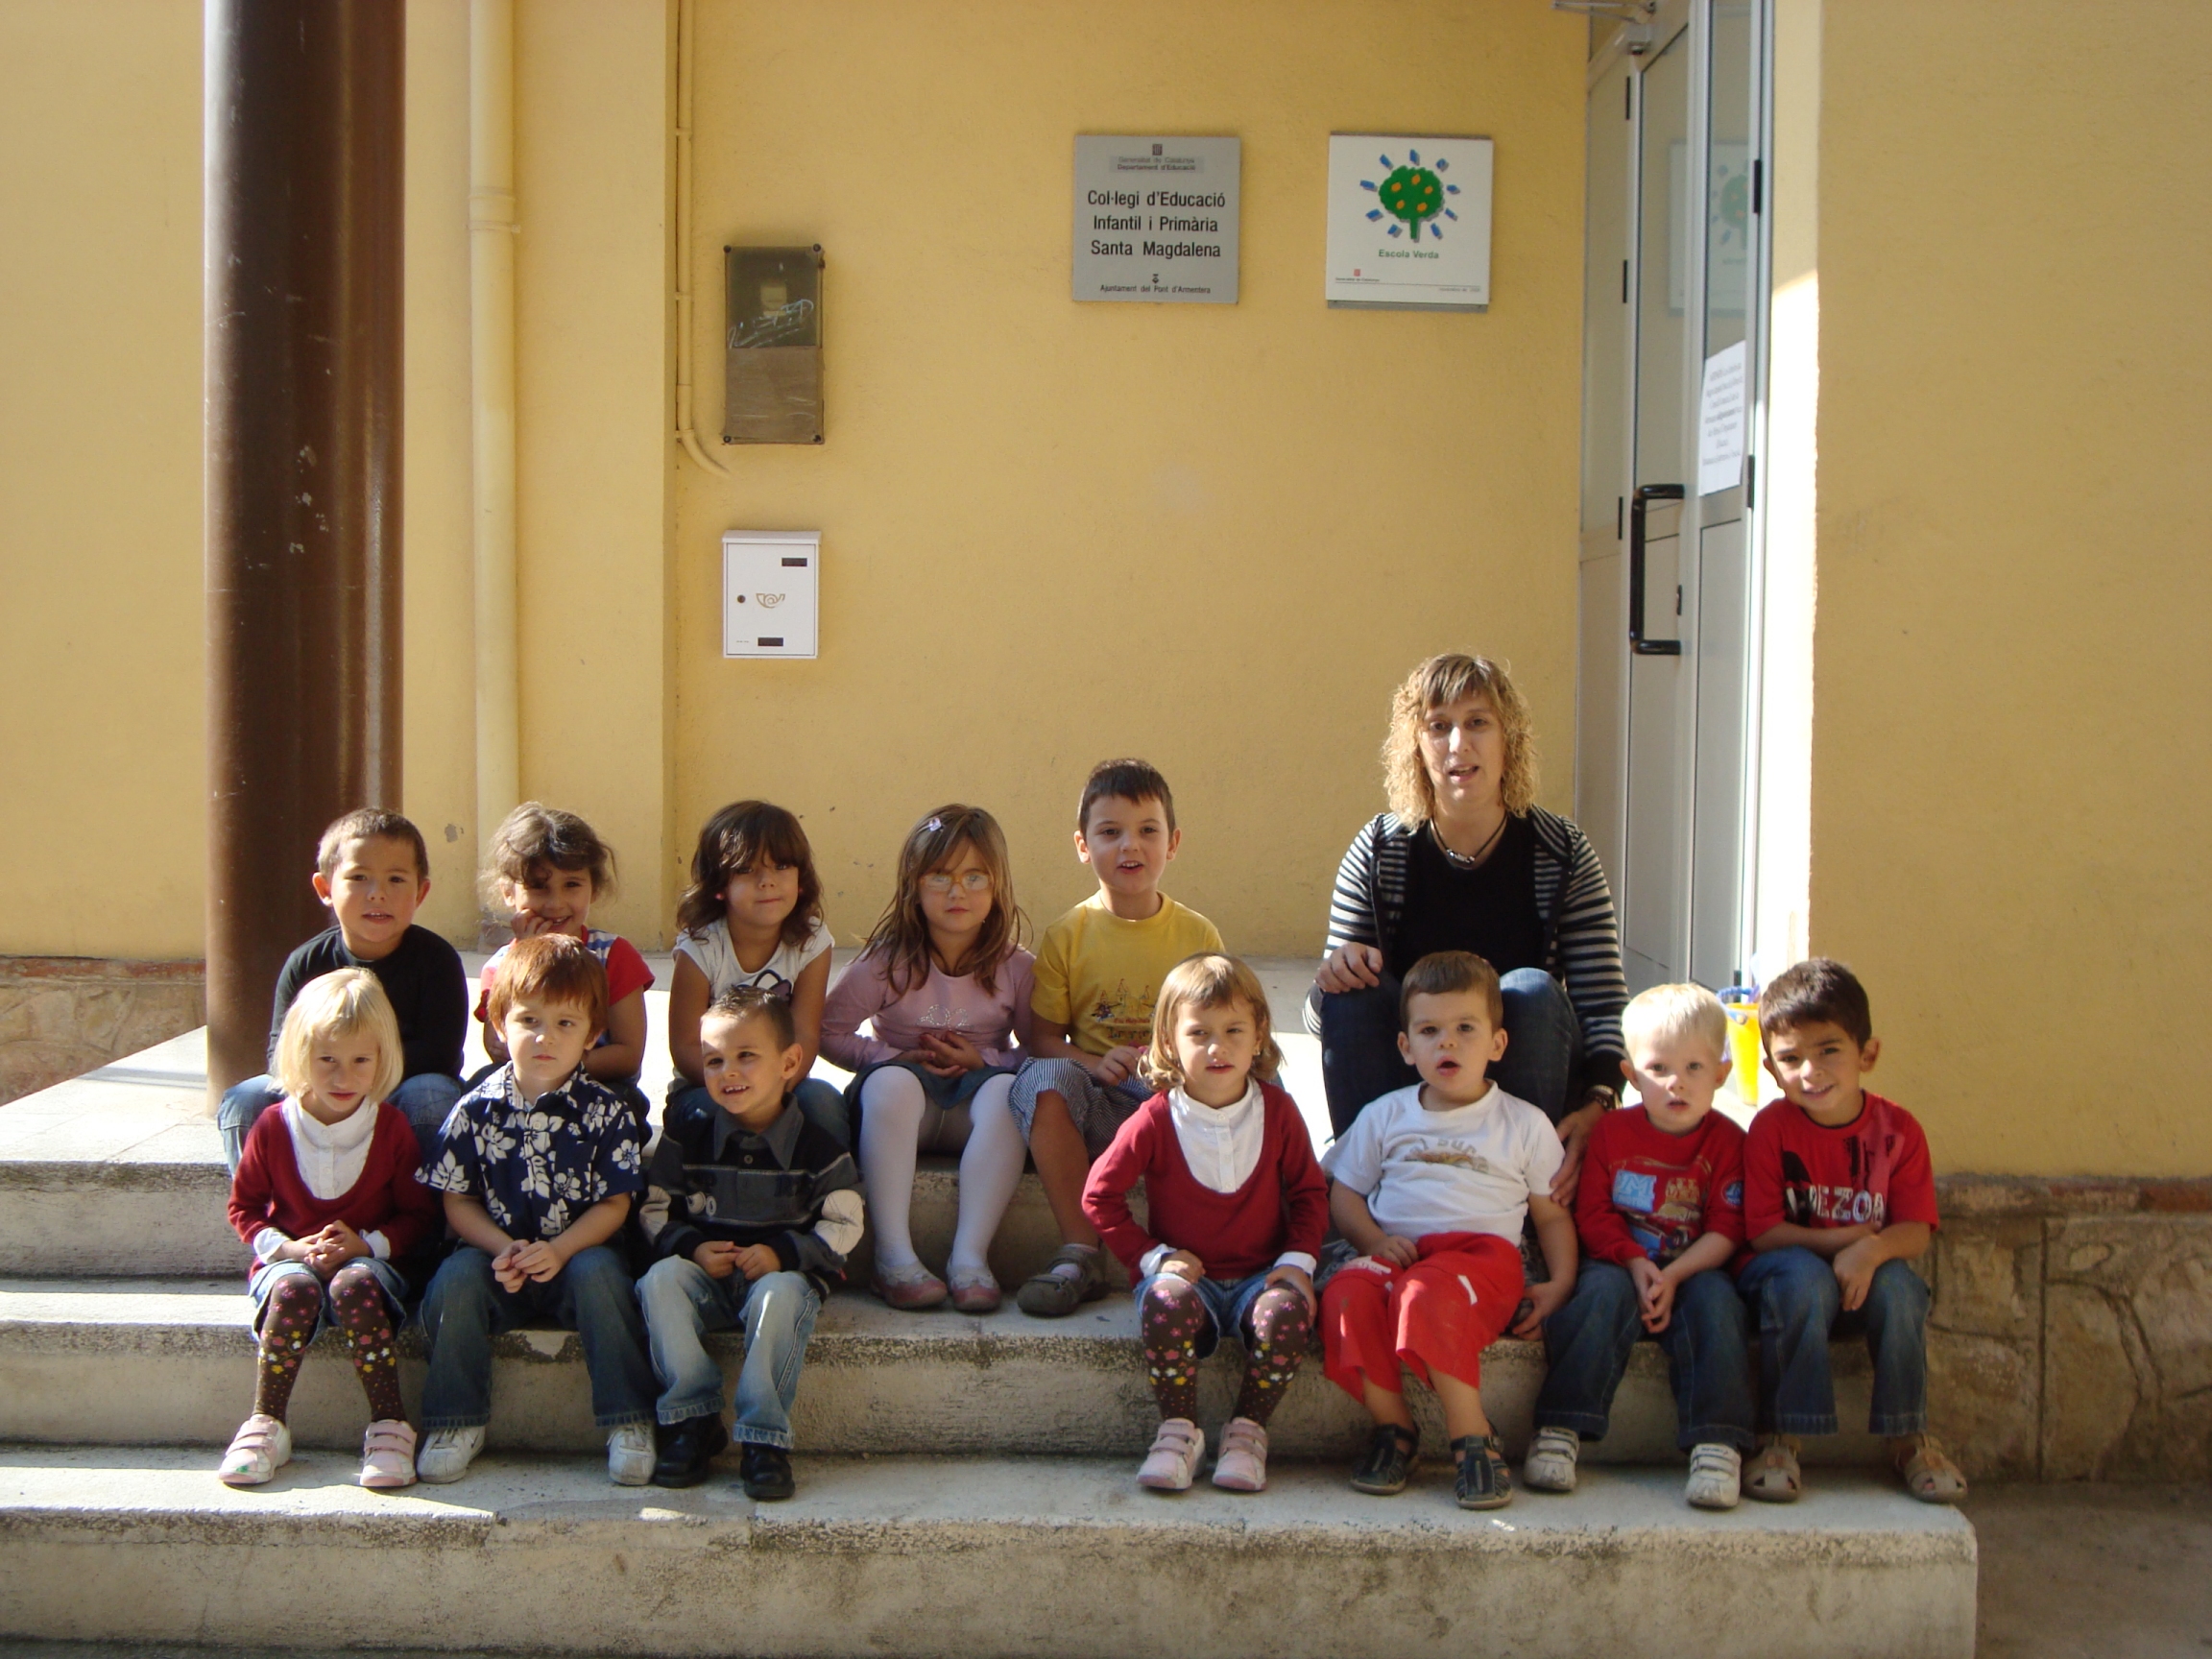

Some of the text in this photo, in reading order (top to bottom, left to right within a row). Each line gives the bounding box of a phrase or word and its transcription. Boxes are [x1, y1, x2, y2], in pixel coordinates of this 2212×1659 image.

[1146, 191, 1225, 207] d'Educació
[1094, 215, 1218, 232] Infantil i Primària
[1091, 240, 1221, 259] Santa Magdalena
[1379, 249, 1439, 259] Escola Verda
[1100, 284, 1137, 293] Ajuntament
